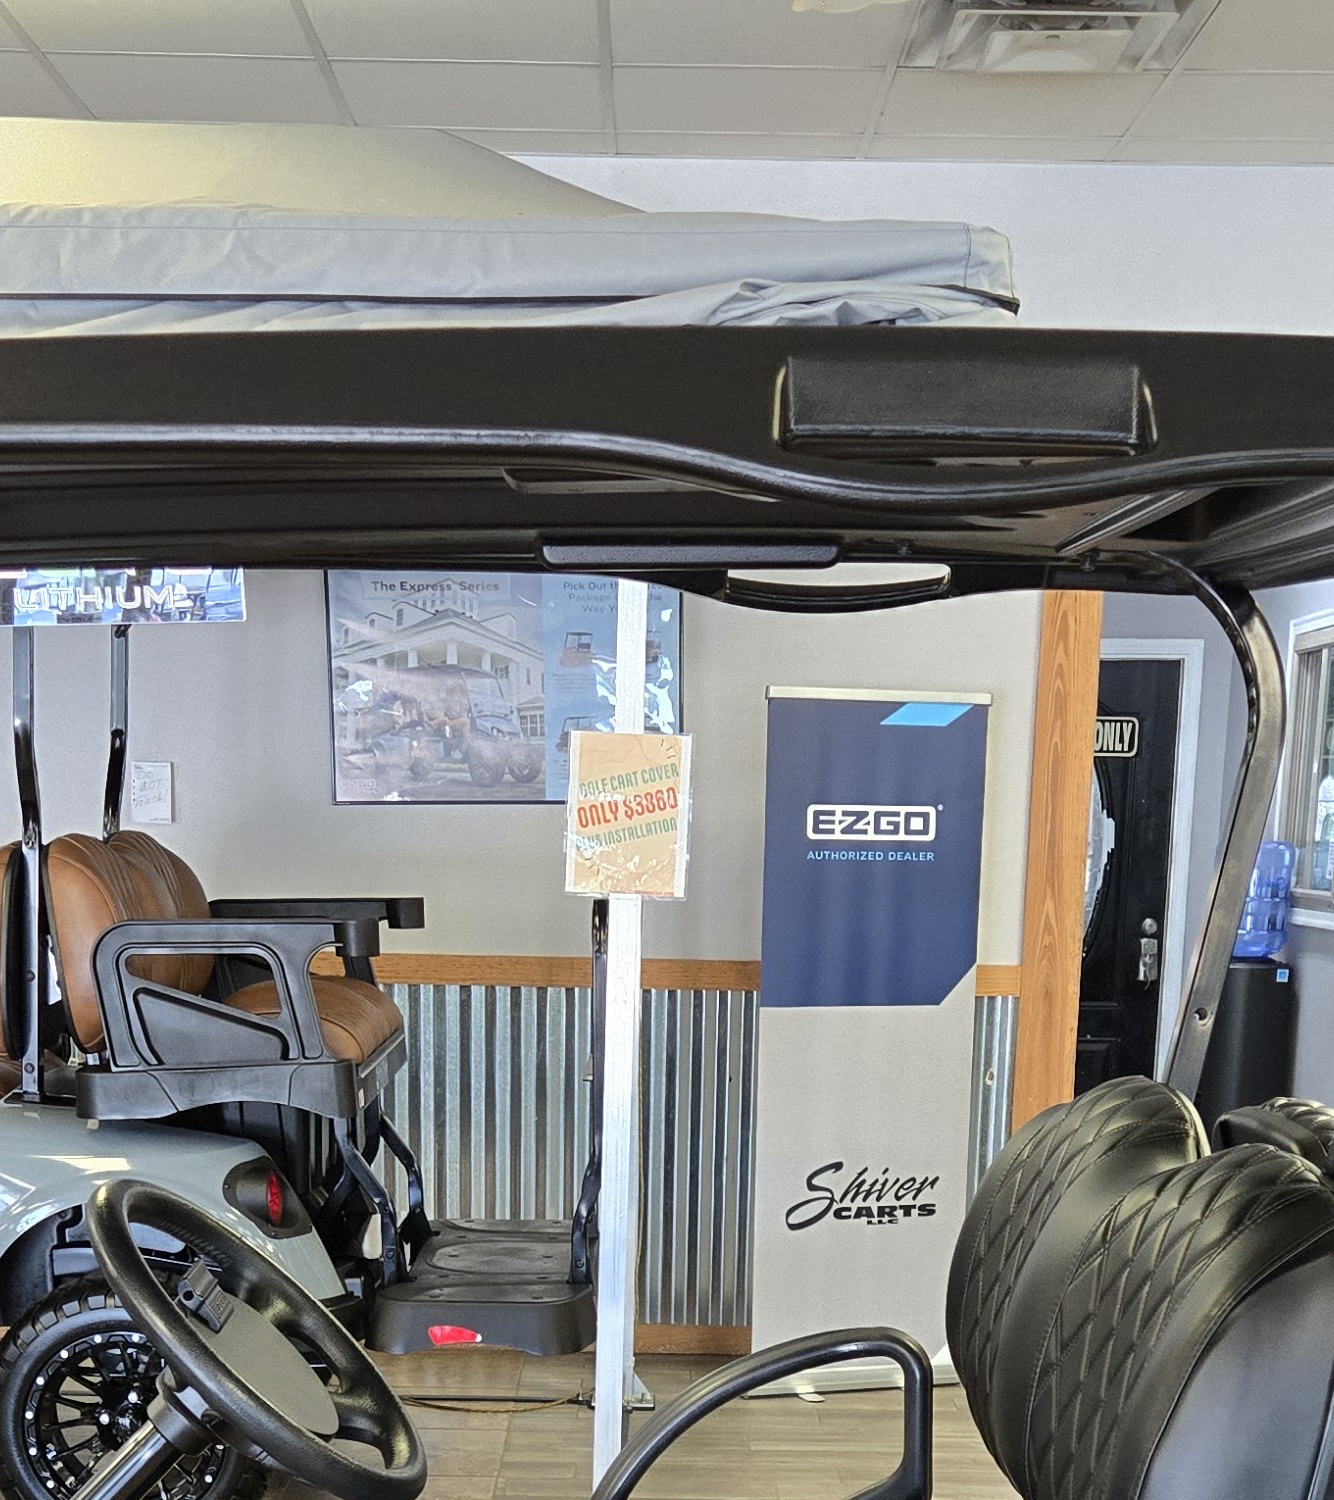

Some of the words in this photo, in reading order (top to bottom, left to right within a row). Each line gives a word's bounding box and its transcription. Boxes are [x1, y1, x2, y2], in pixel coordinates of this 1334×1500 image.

[13, 583, 175, 612] LITHIUM
[370, 580, 396, 592] The
[399, 580, 452, 594] Express
[459, 580, 500, 592] Series
[563, 581, 585, 591] Pick
[588, 581, 606, 591] Out
[568, 592, 613, 604] Package
[1094, 721, 1133, 751] ONLY
[579, 778, 608, 798] GOLF
[609, 771, 639, 791] CART
[641, 762, 680, 785] COVER
[577, 799, 619, 829] ONLY
[622, 786, 678, 821] $3860
[602, 816, 678, 847] INSTALLATION
[810, 807, 933, 838] EZGO
[806, 850, 884, 861] AUTHORIZED
[888, 851, 935, 862] DEALER
[785, 1161, 940, 1231] Shiver
[833, 1203, 937, 1220] CARTS
